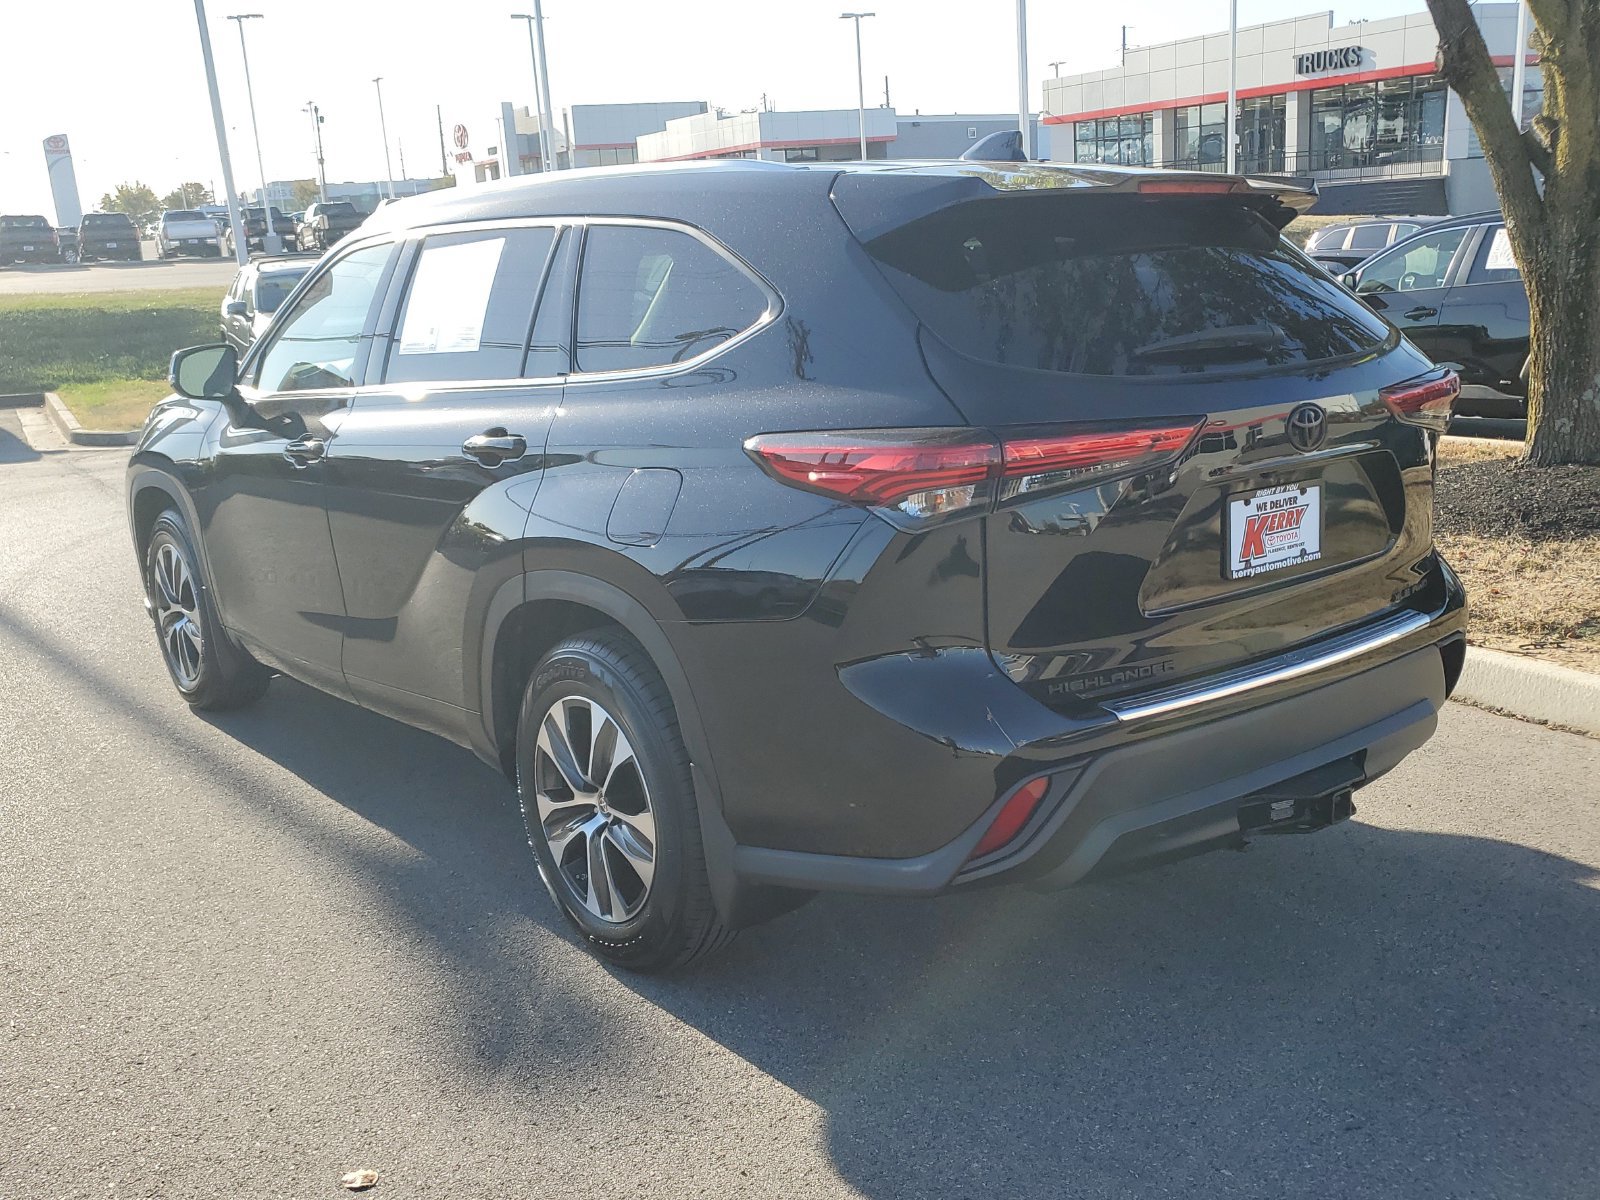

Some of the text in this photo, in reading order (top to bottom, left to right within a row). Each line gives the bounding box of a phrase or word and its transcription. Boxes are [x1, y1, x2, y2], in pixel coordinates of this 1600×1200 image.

[1293, 45, 1362, 74] TRUCKS
[1255, 483, 1300, 497] RIGHT BY YOU
[1256, 495, 1298, 513] WE DELIVER
[1241, 506, 1306, 561] KERRY
[1276, 532, 1298, 542] TOYOTA
[1232, 552, 1321, 579] kerryautomotive.com
[1048, 660, 1175, 695] HIGHLANDER
